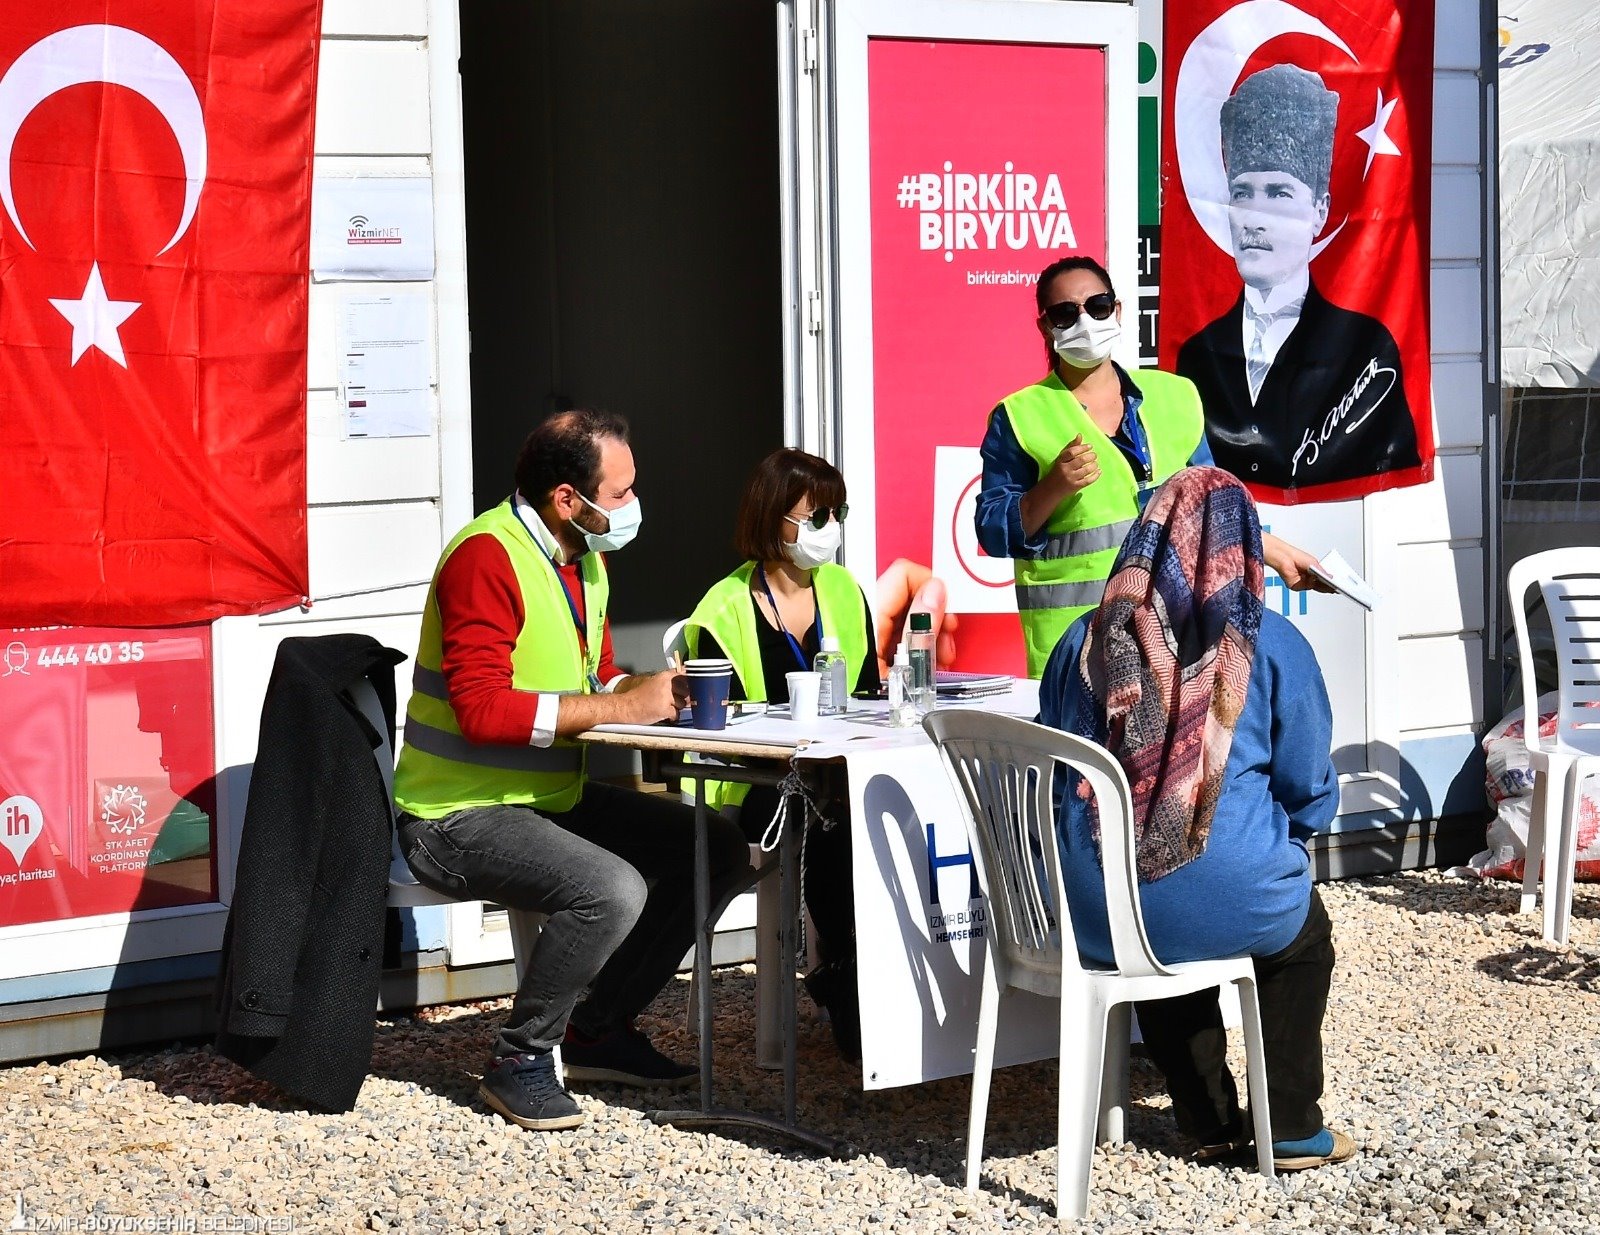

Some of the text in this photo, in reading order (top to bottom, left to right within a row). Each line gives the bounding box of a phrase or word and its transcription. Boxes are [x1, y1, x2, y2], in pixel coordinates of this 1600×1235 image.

[896, 161, 1068, 211] #BİRKİRA
[967, 270, 1041, 287] birkirabiryu
[37, 641, 145, 668] 444 40 35
[105, 837, 148, 850] STK AFET
[957, 906, 987, 925] BÜYÜ
